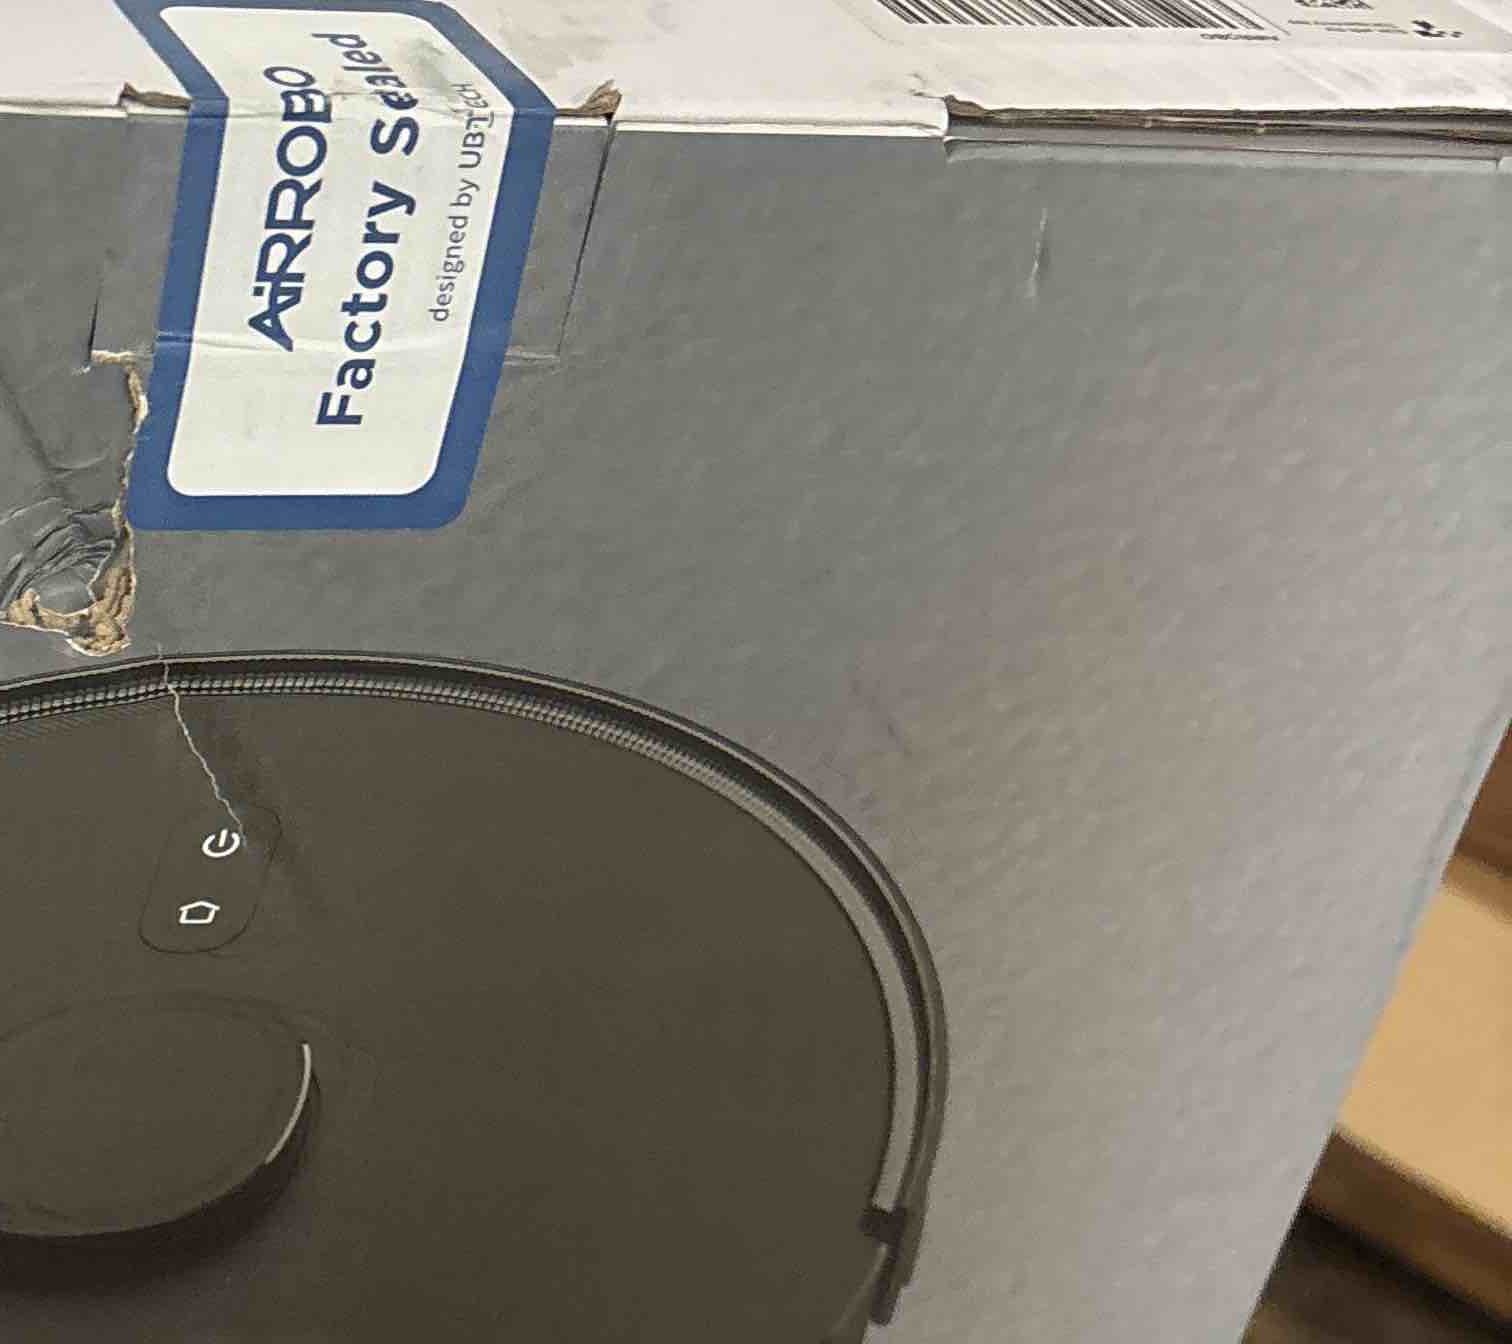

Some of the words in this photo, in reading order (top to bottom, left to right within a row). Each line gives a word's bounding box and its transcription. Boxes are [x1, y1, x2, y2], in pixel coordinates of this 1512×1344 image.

[310, 32, 420, 156] Sealed
[315, 180, 417, 426] Factory
[427, 215, 470, 323] designed
[451, 178, 480, 208] by
